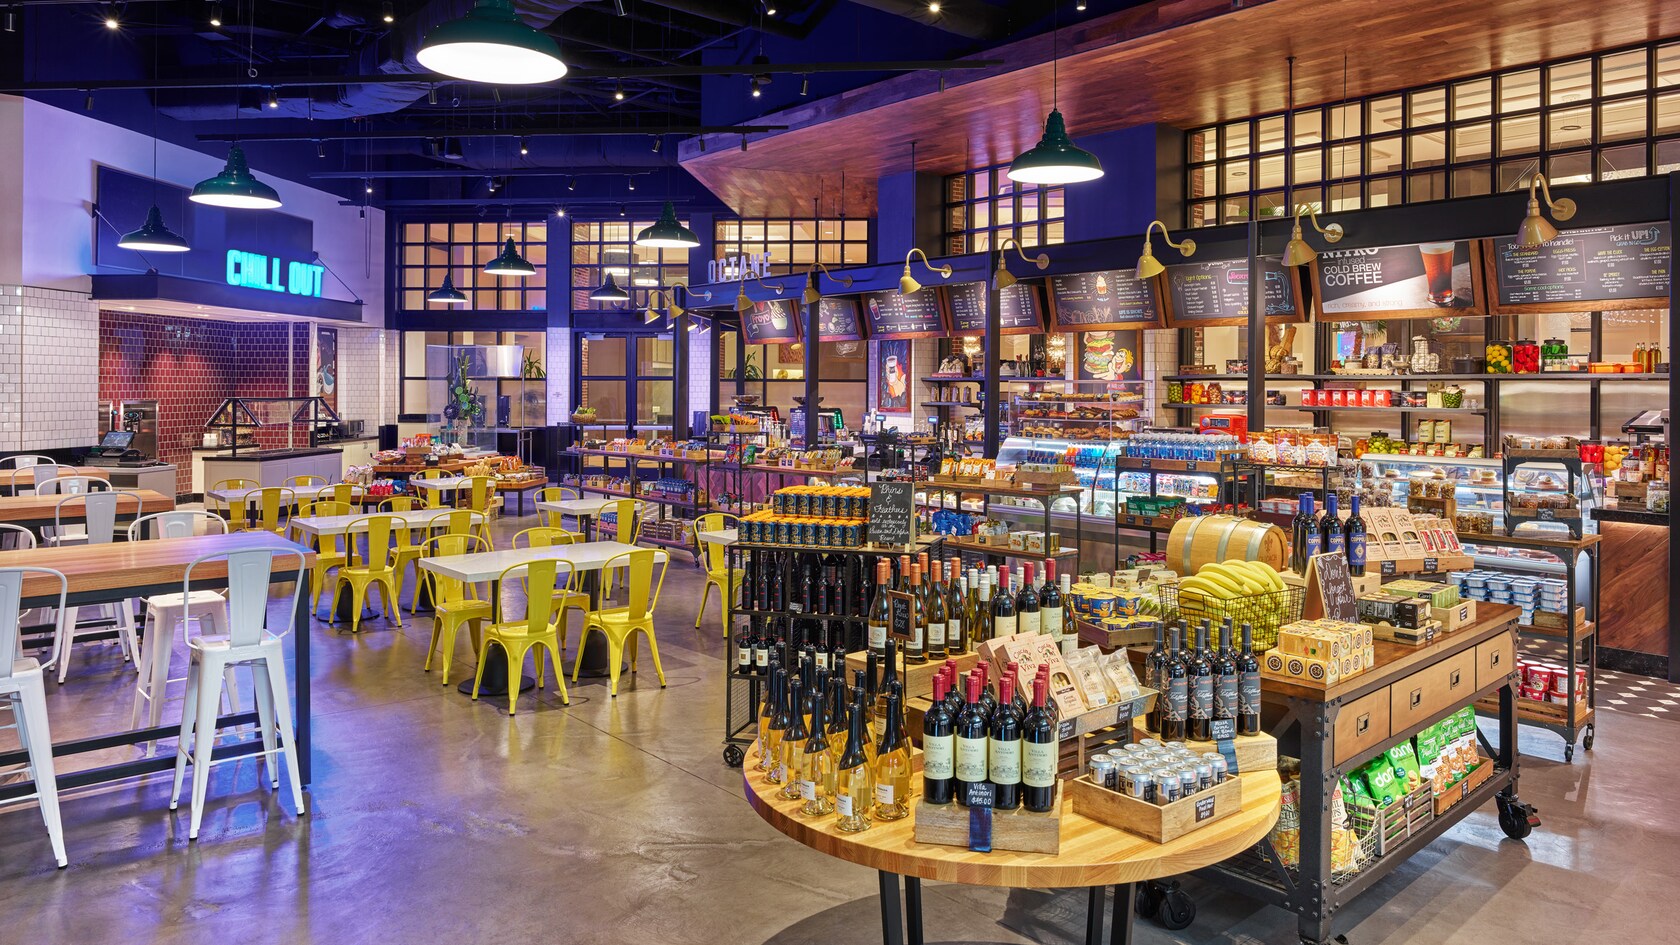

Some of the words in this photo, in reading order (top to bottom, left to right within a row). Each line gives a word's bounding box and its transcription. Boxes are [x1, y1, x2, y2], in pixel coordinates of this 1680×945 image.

[1610, 233, 1624, 242] Pick
[1624, 233, 1630, 241] it
[1631, 230, 1649, 240] UP!
[1337, 256, 1365, 265] infused
[227, 249, 285, 292] CHILL
[288, 261, 324, 298] OUT
[708, 251, 772, 284] OCTANE
[1323, 265, 1350, 275] COLD
[1352, 262, 1381, 273] BREW
[1325, 271, 1383, 287] COFFEE
[1020, 663, 1036, 672] Viva
